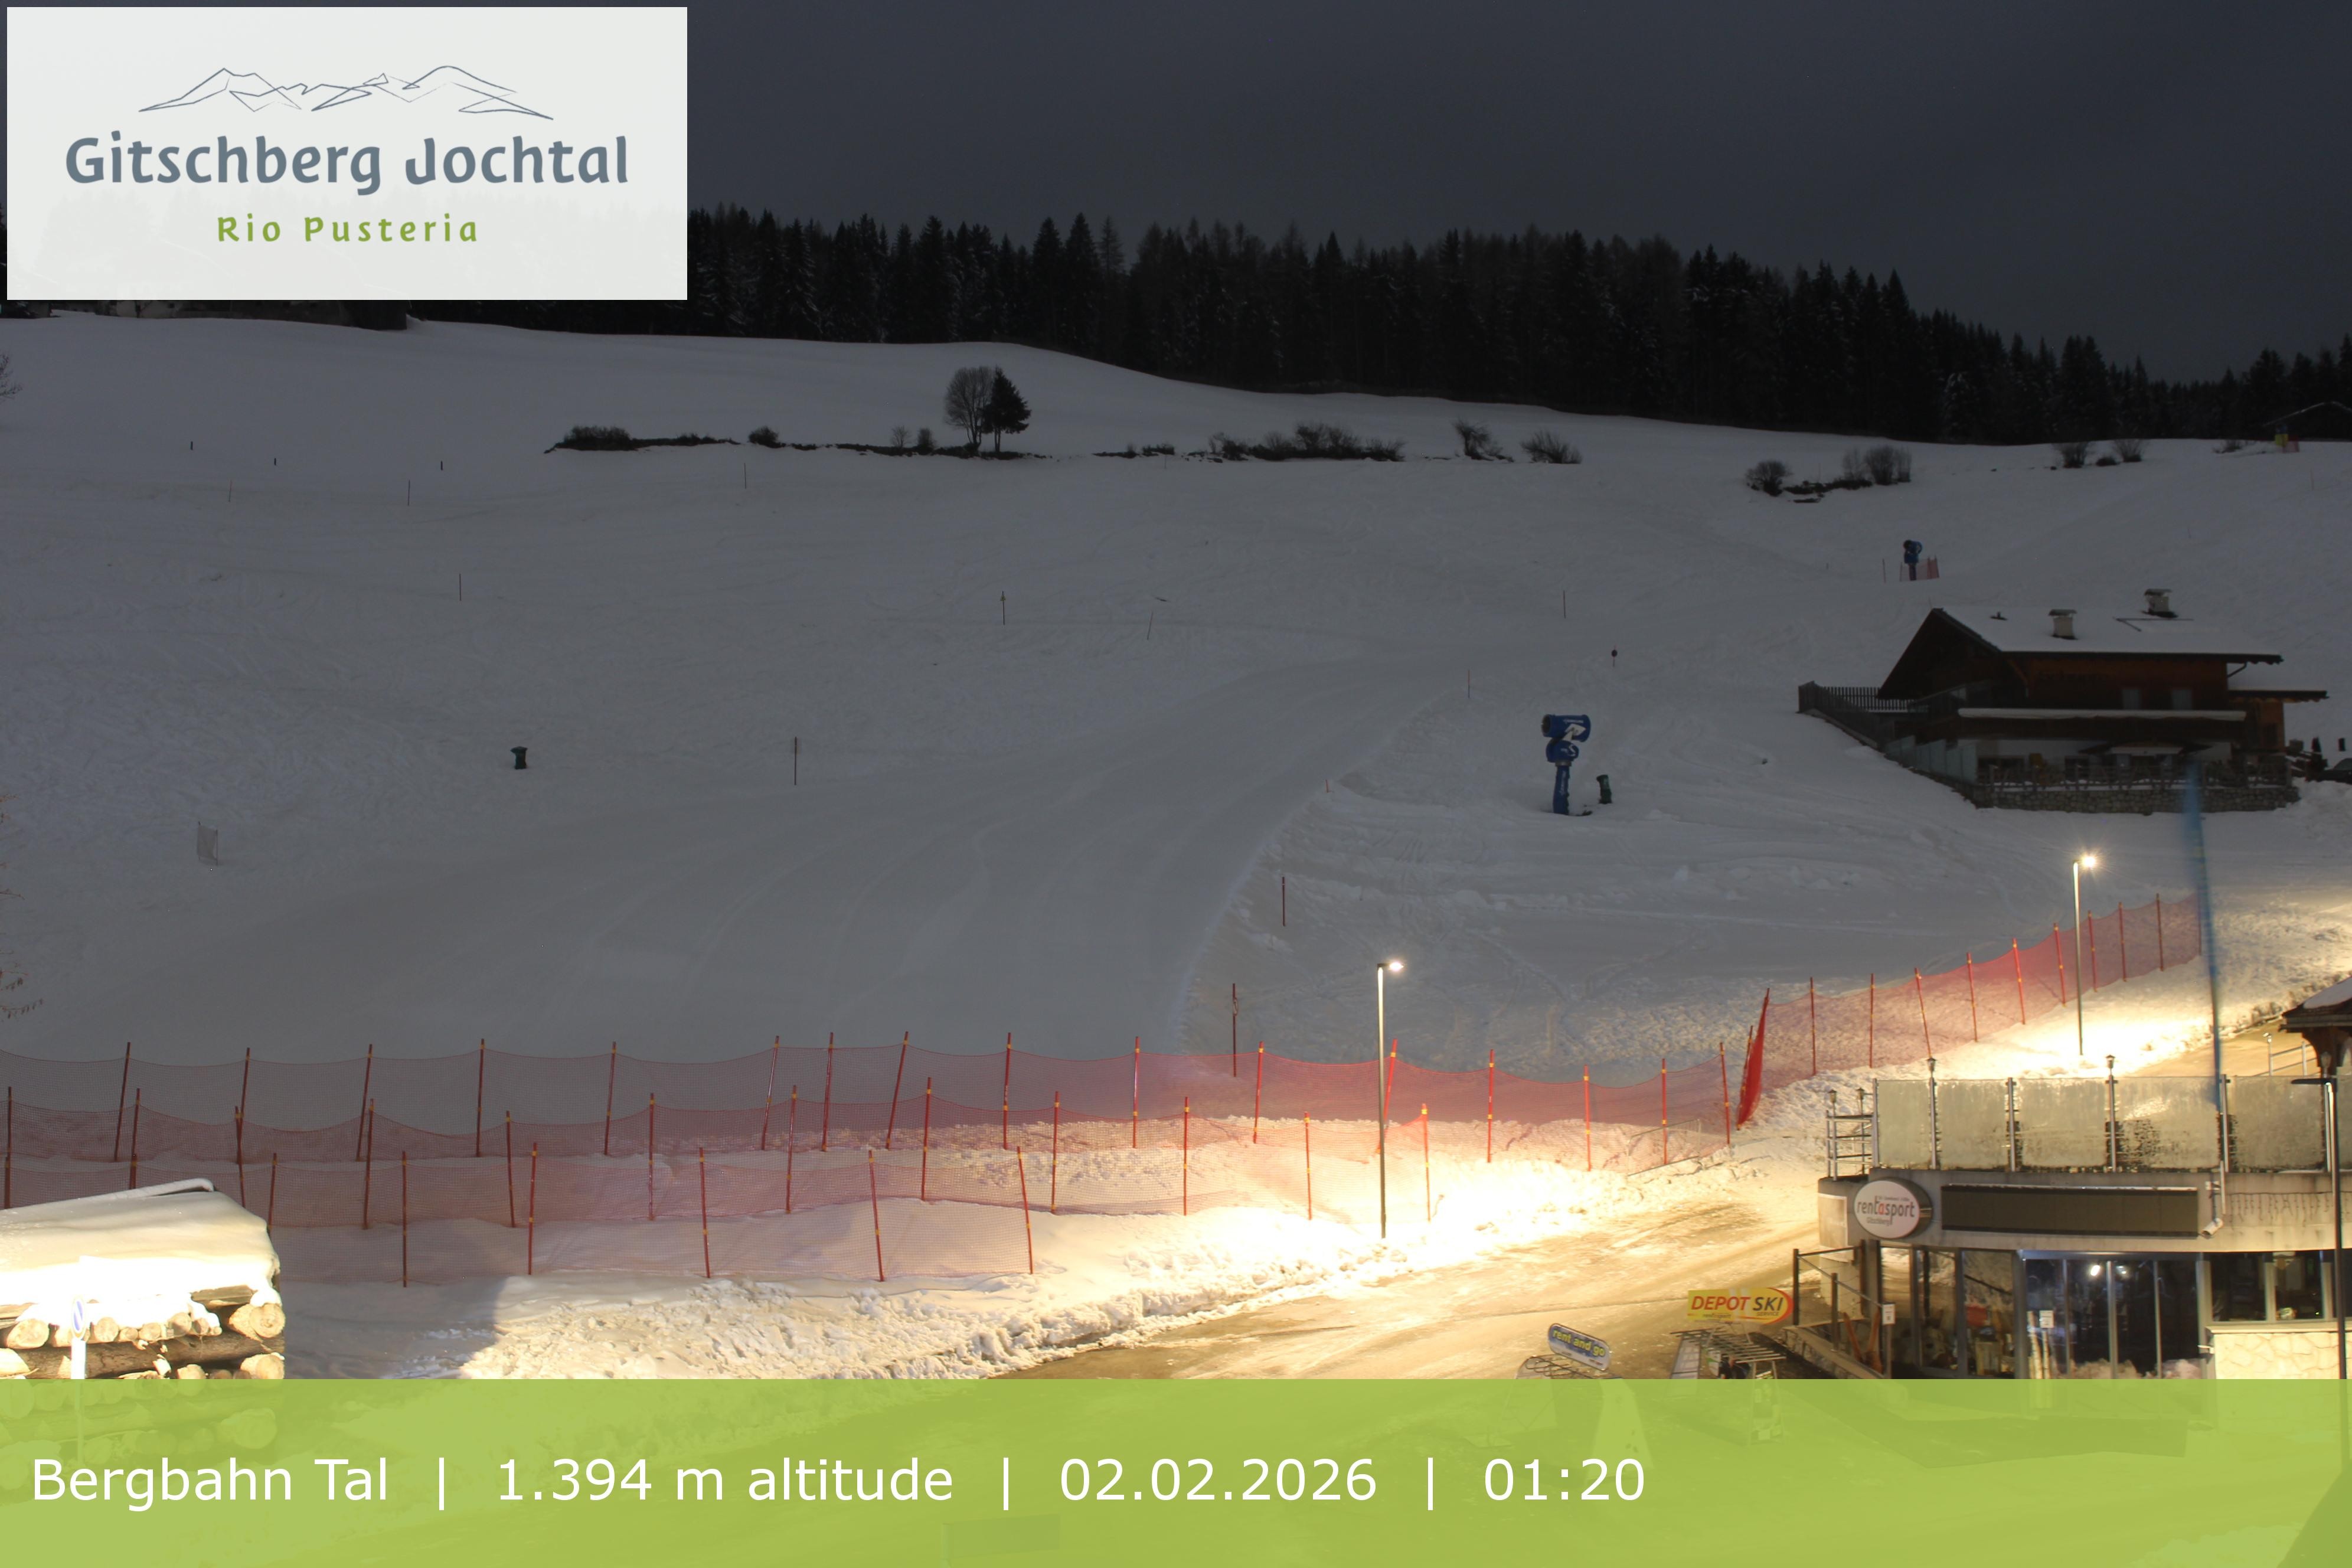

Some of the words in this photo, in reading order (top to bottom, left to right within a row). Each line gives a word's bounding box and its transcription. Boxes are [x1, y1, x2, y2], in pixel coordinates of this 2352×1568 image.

[1857, 1195, 1915, 1225] rentasport
[1691, 1296, 1751, 1311] DEPOT
[1752, 1296, 1783, 1311] SKI
[1552, 1329, 1572, 1344] rent
[1573, 1338, 1592, 1352] and
[1592, 1345, 1605, 1357] go
